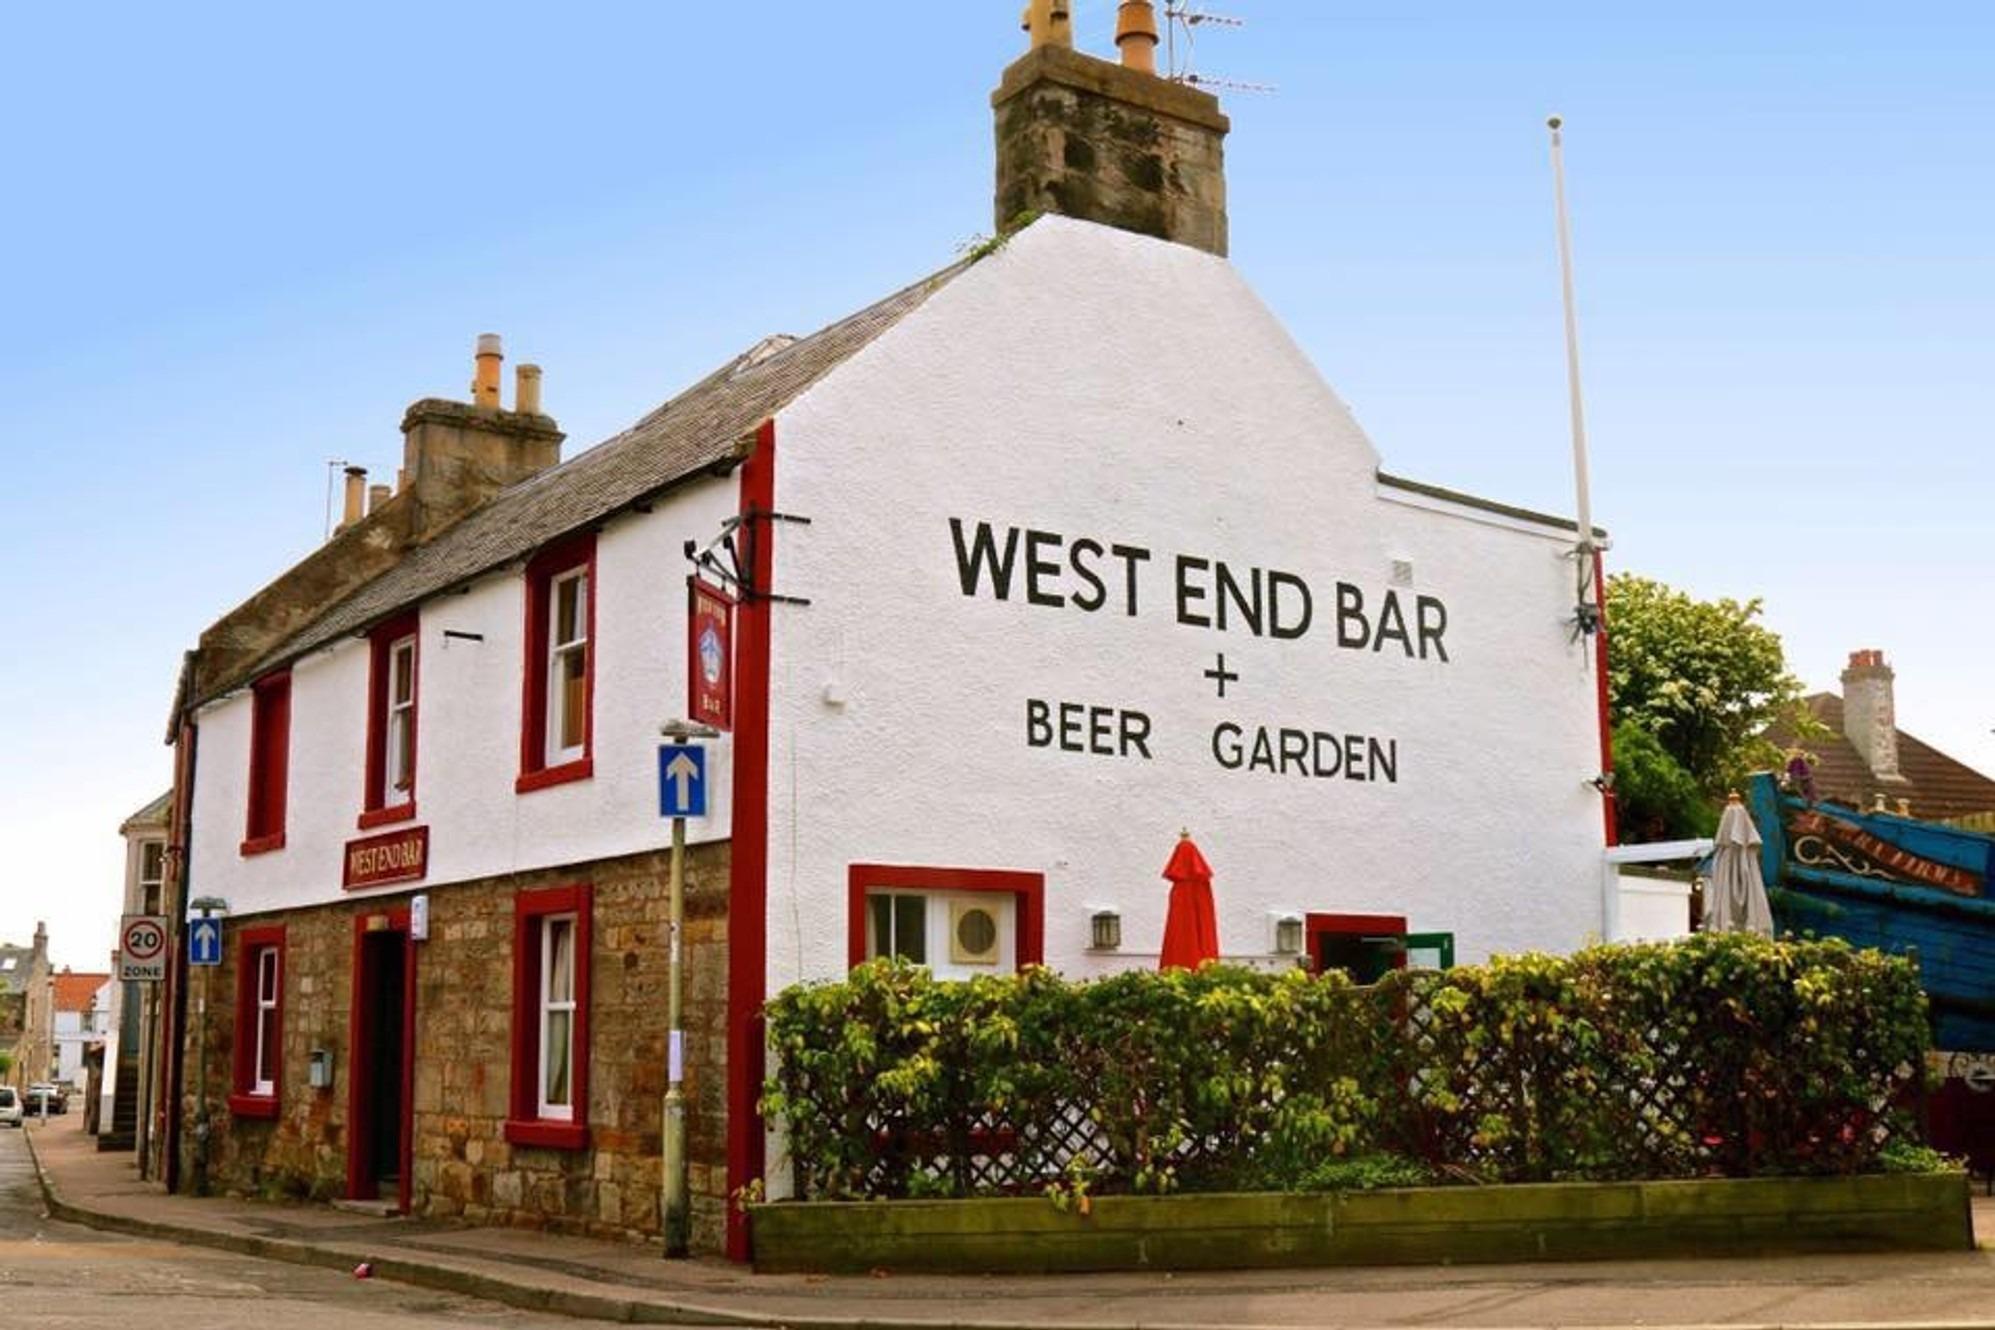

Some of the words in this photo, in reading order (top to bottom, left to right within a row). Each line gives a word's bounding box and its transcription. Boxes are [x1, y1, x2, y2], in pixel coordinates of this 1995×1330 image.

[948, 517, 1151, 617] WEST
[1176, 554, 1313, 640] END
[1336, 581, 1449, 662] BAR
[1204, 653, 1239, 698] +
[1027, 698, 1152, 759] BEER
[1212, 722, 1397, 783] GARDEN
[351, 847, 377, 874] WEST
[378, 845, 401, 871] END
[401, 839, 423, 868] BAR
[131, 931, 157, 948] 20
[124, 966, 162, 977] ZONE
